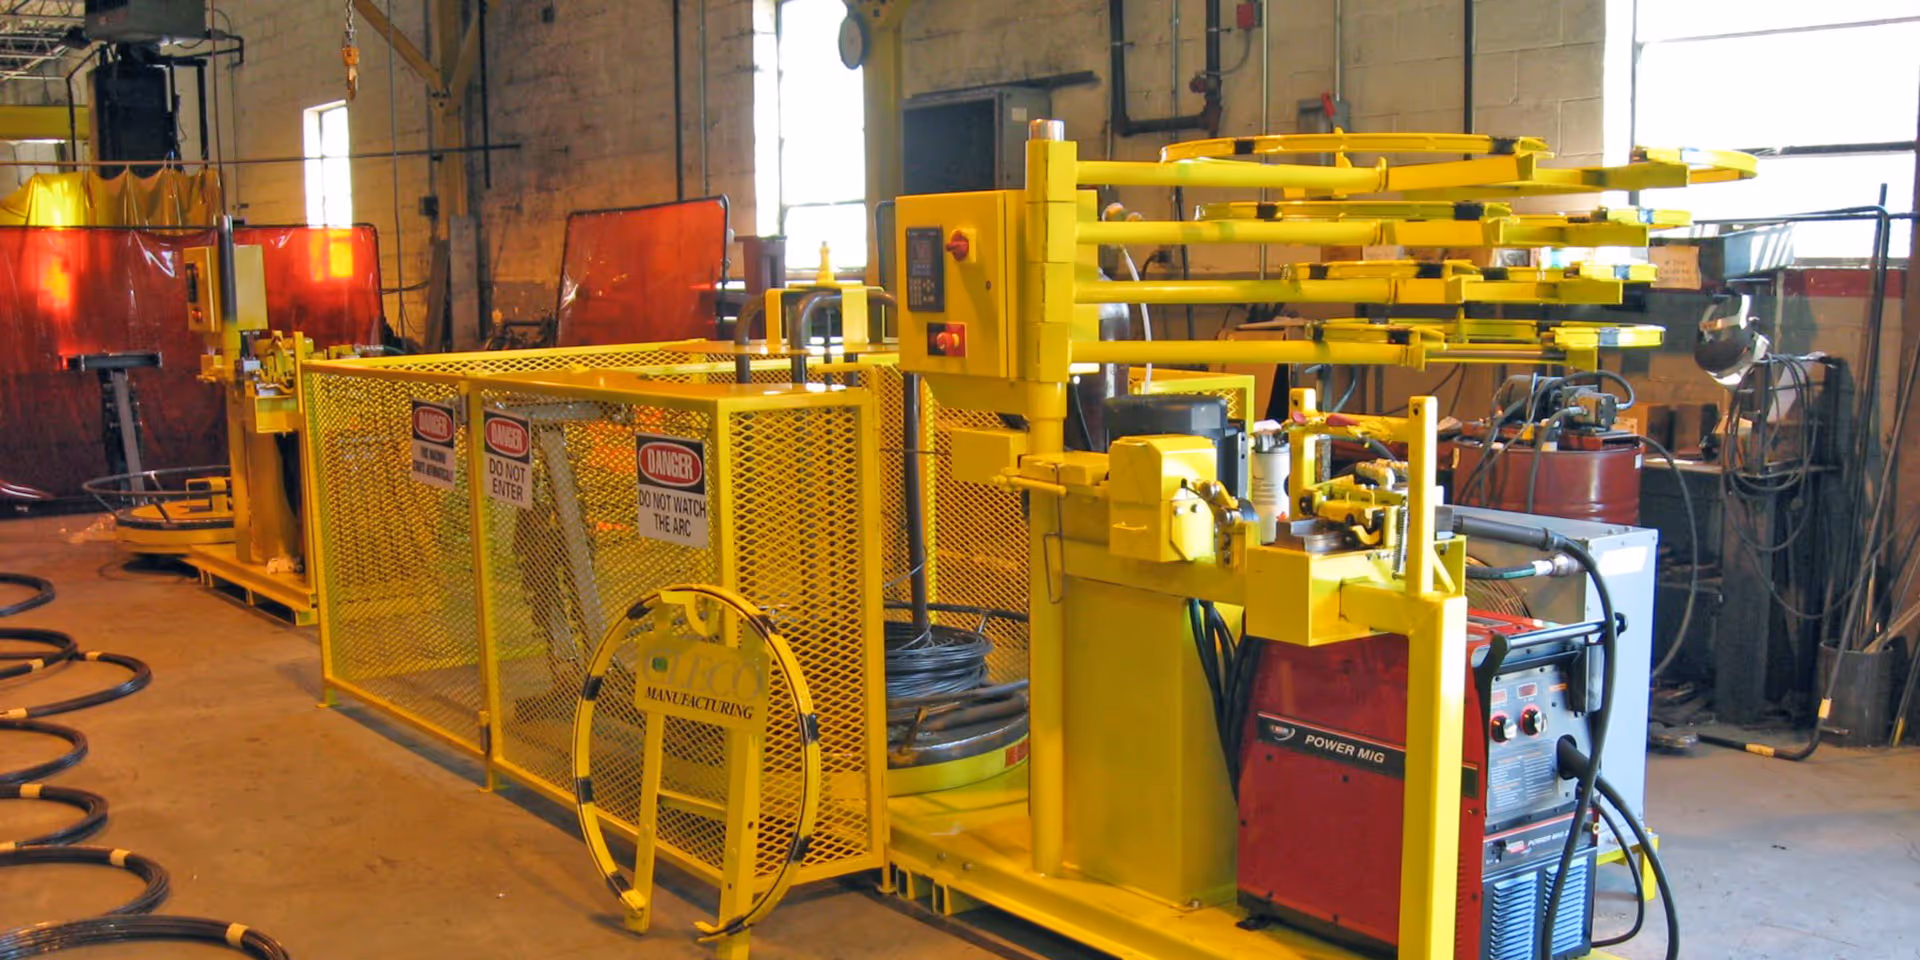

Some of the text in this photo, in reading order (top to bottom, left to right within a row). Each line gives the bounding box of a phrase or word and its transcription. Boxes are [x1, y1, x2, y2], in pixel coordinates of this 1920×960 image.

[418, 410, 448, 437] DANGER
[490, 422, 524, 452] DANGER
[489, 458, 526, 484] DO NOT
[646, 447, 694, 480] DANGER
[492, 478, 524, 502] ENTER
[638, 488, 707, 519] DO NOT WATCH
[653, 513, 692, 538] THE ARC
[644, 685, 755, 721] MANUFACTURING
[1304, 734, 1386, 764] POWER MIG
